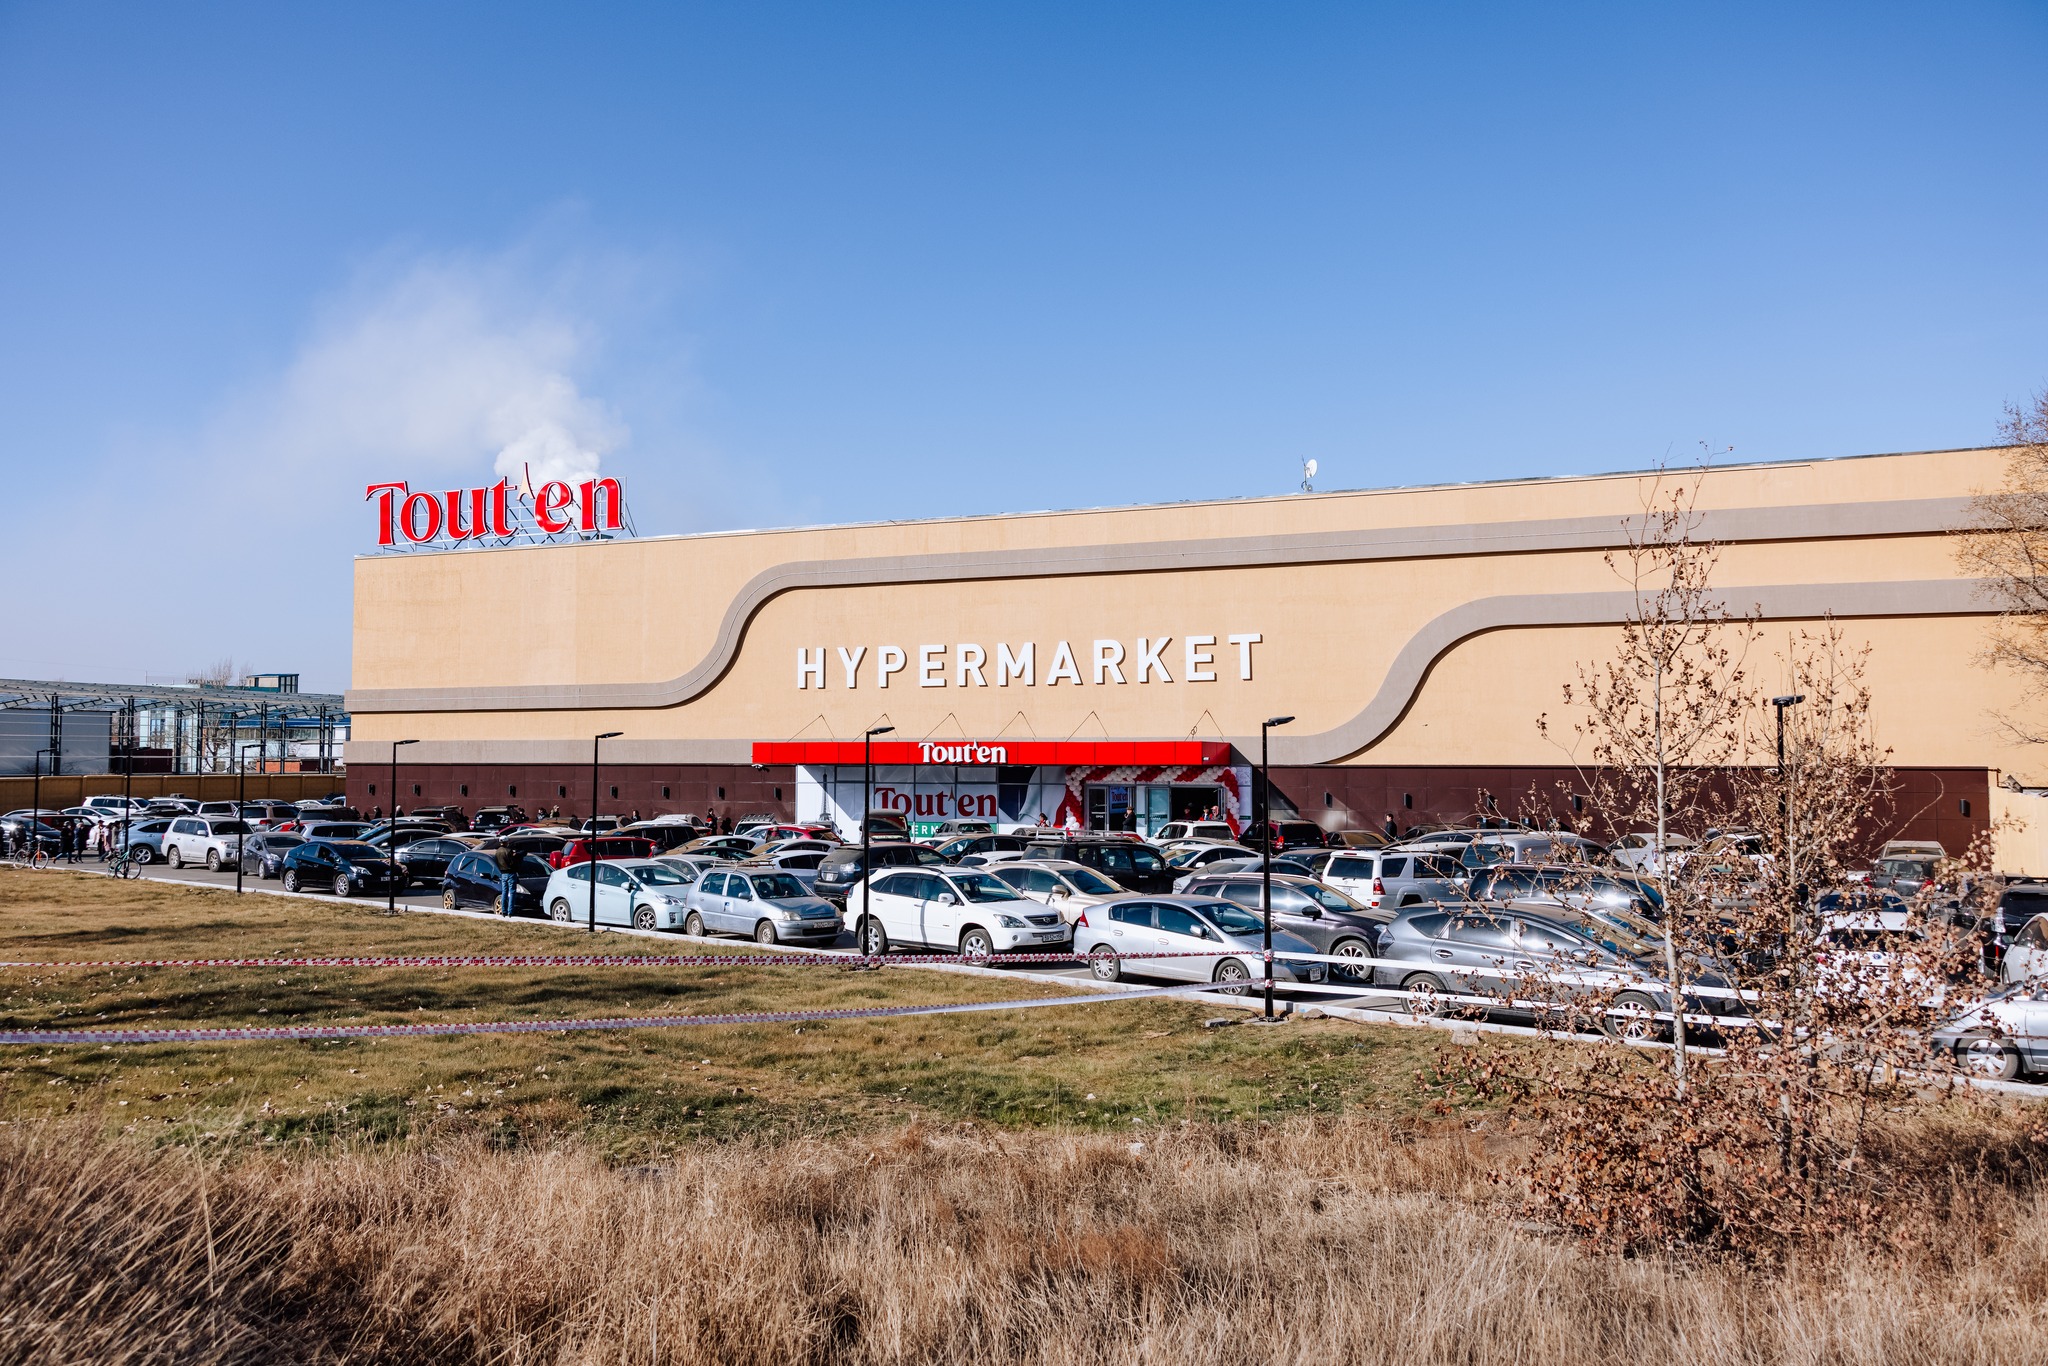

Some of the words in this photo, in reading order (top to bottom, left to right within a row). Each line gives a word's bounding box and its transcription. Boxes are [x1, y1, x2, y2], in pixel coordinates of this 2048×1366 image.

[365, 462, 625, 546] Tout'en
[797, 633, 1263, 689] HYPERMARKET
[918, 739, 1007, 763] Tout'en
